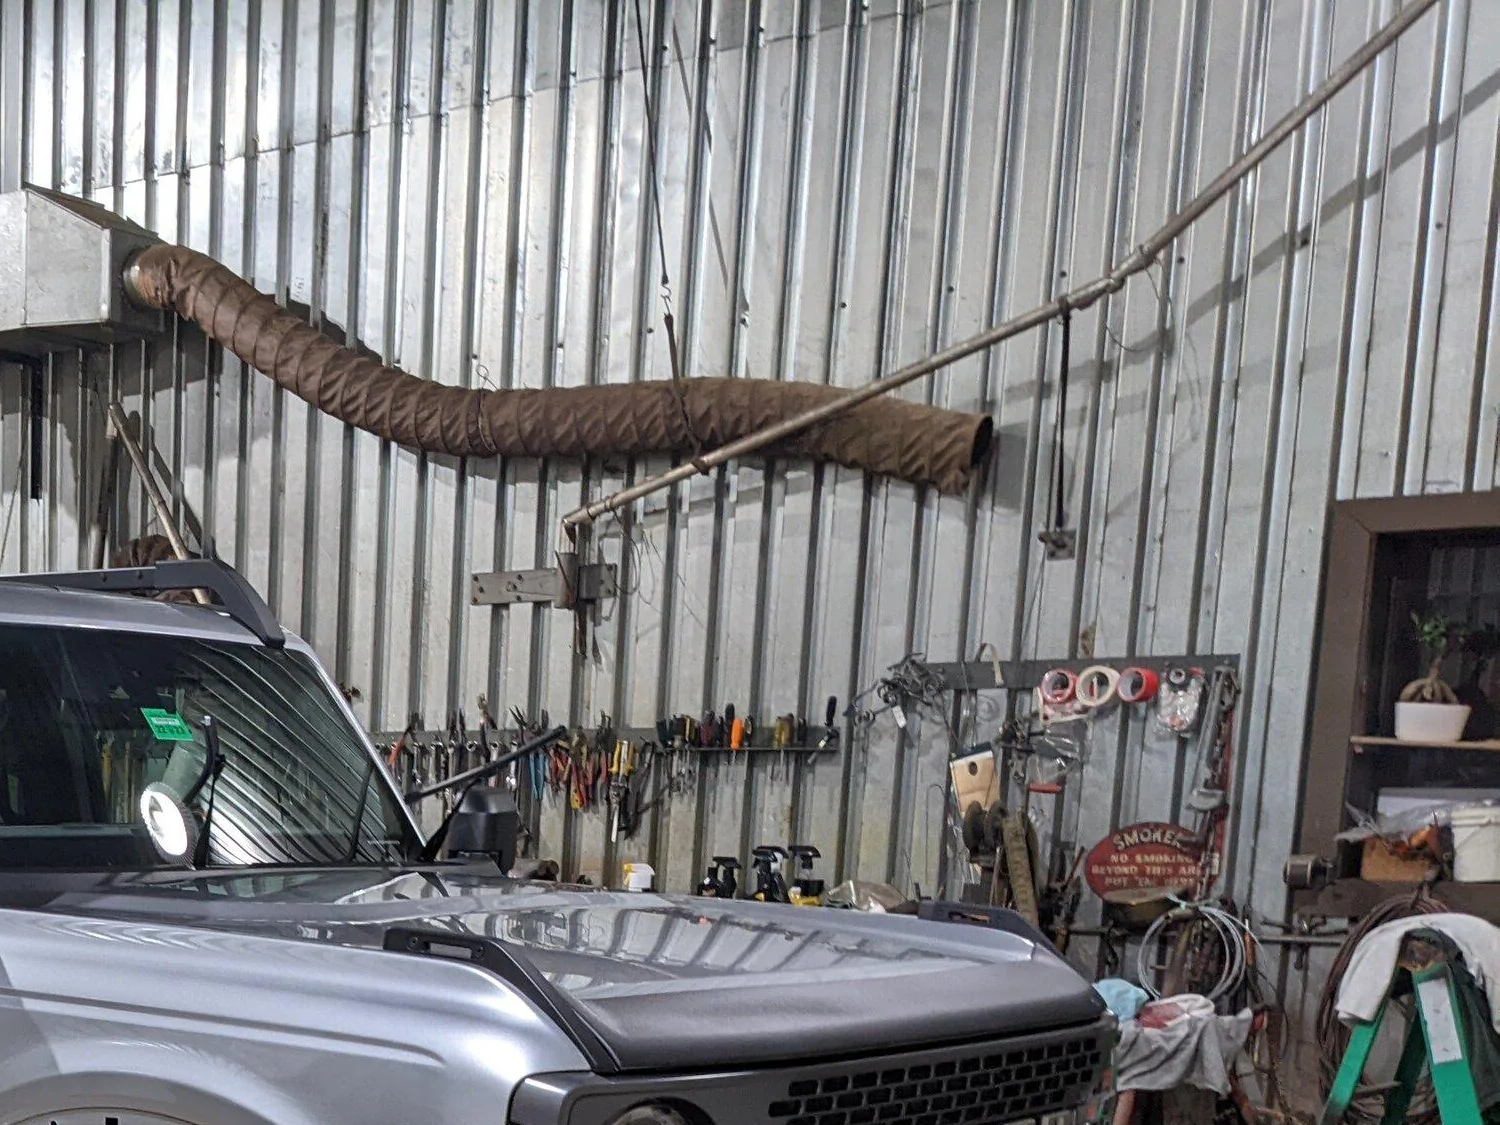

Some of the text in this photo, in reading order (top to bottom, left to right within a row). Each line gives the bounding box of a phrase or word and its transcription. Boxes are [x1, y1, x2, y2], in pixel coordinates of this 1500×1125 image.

[1110, 854, 1128, 863] NO
[1091, 865, 1138, 875] BEYOND
[1144, 866, 1173, 876] THIS
